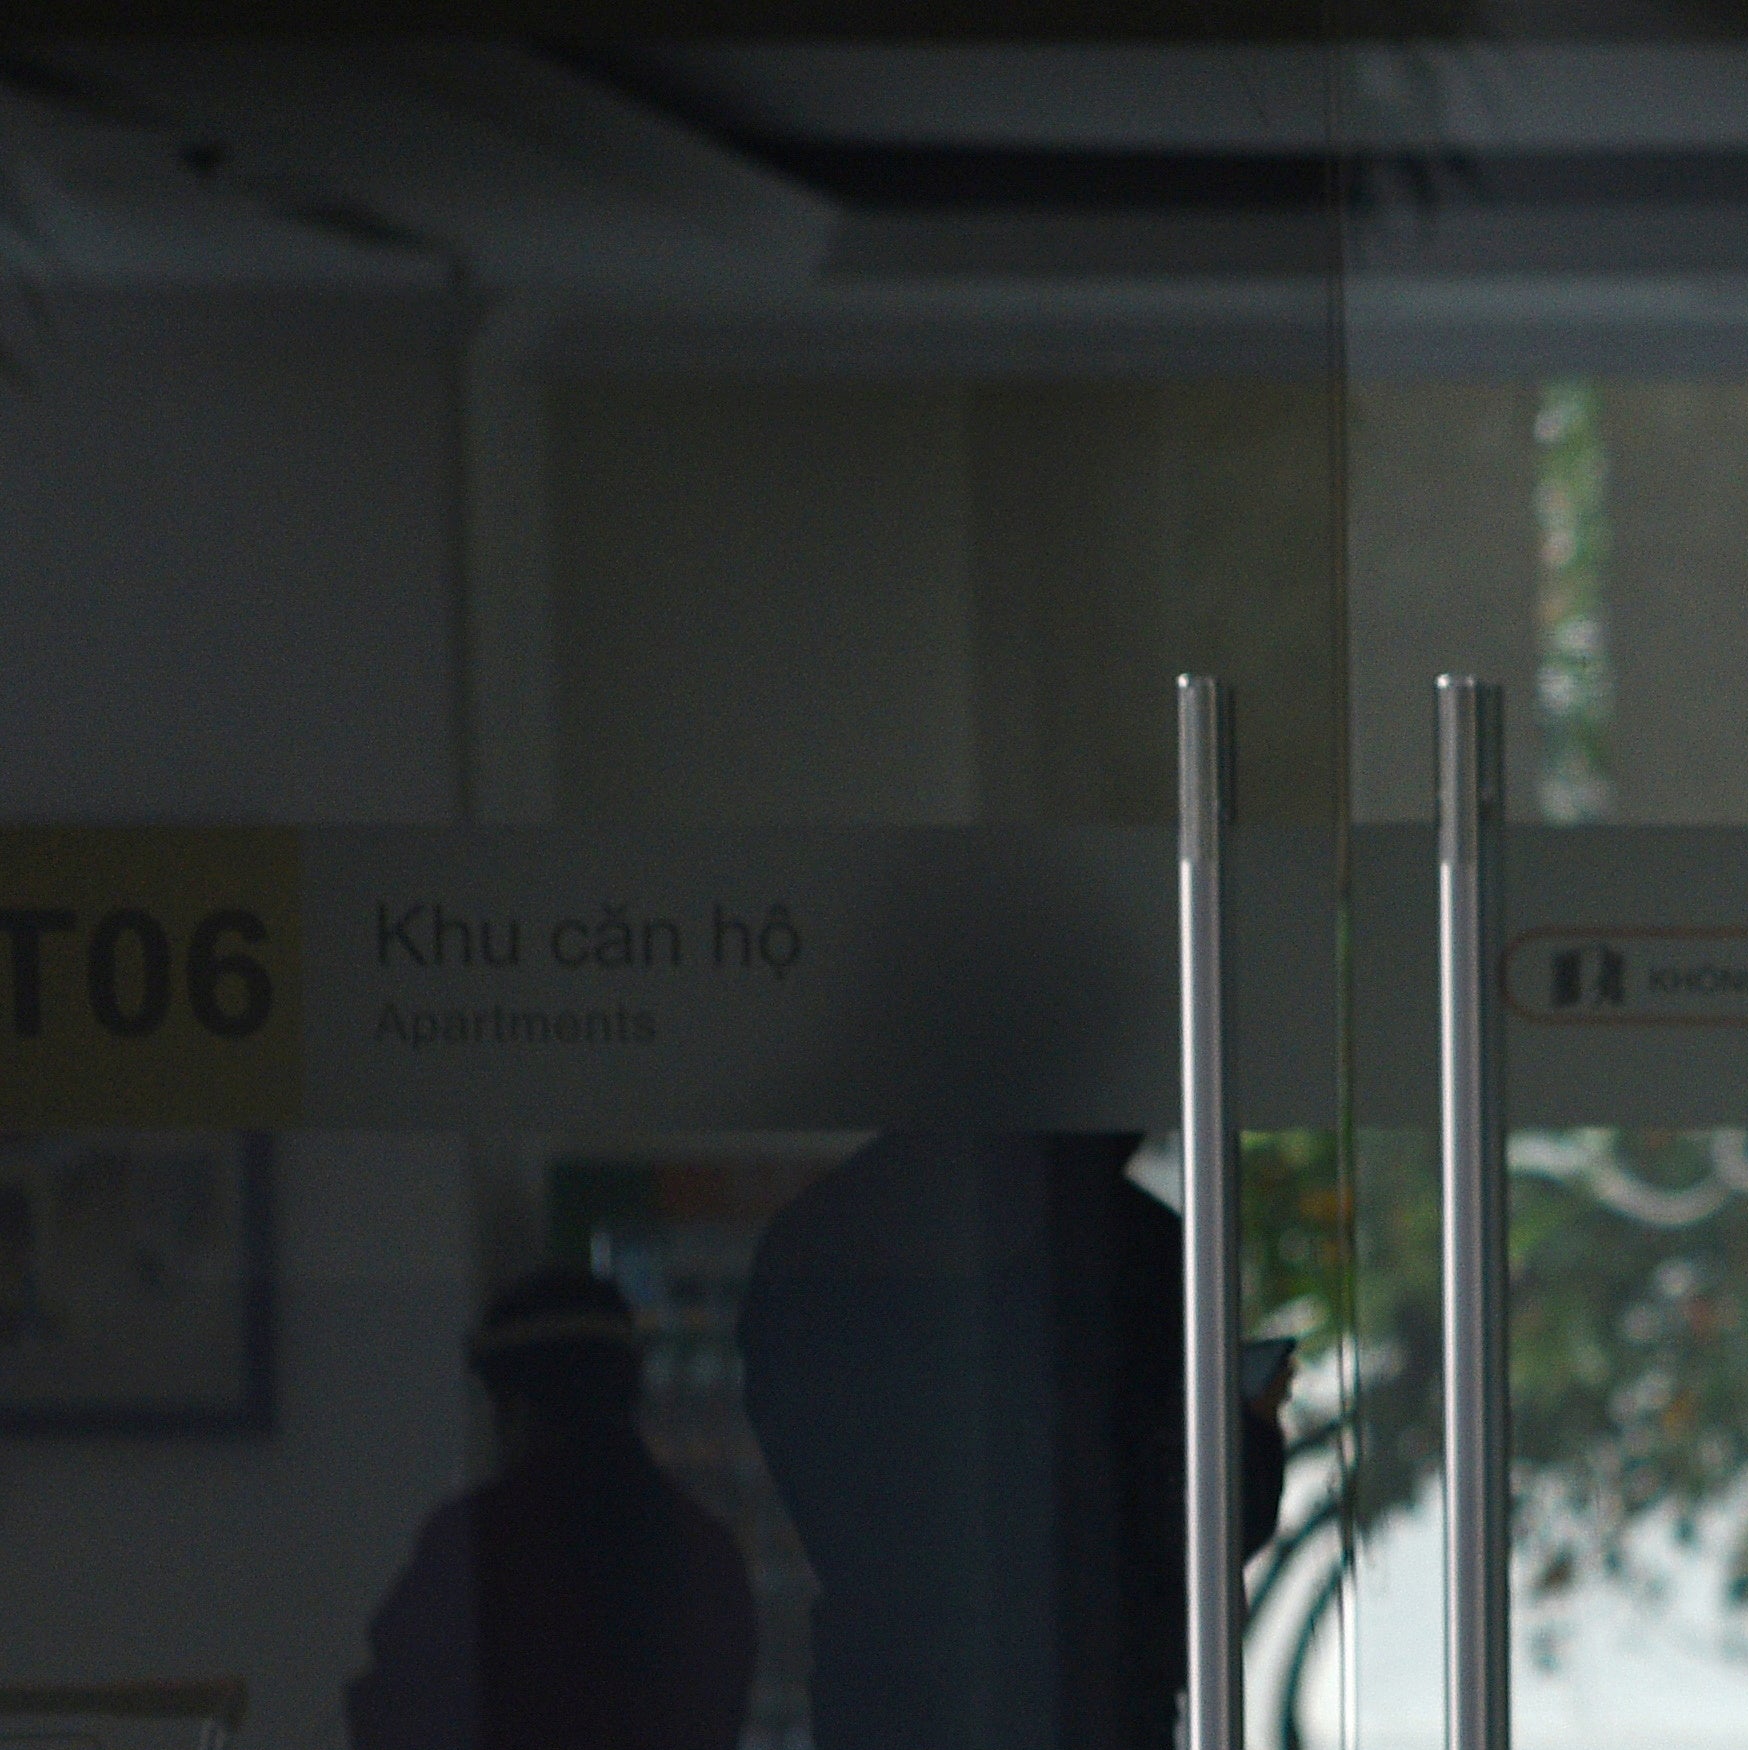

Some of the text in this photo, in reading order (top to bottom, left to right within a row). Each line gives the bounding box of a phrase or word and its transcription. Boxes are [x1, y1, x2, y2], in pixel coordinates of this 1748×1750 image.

[0, 907, 275, 1040] T06
[375, 902, 804, 982] Khu căn hộ
[373, 1000, 659, 1049] Apartments
